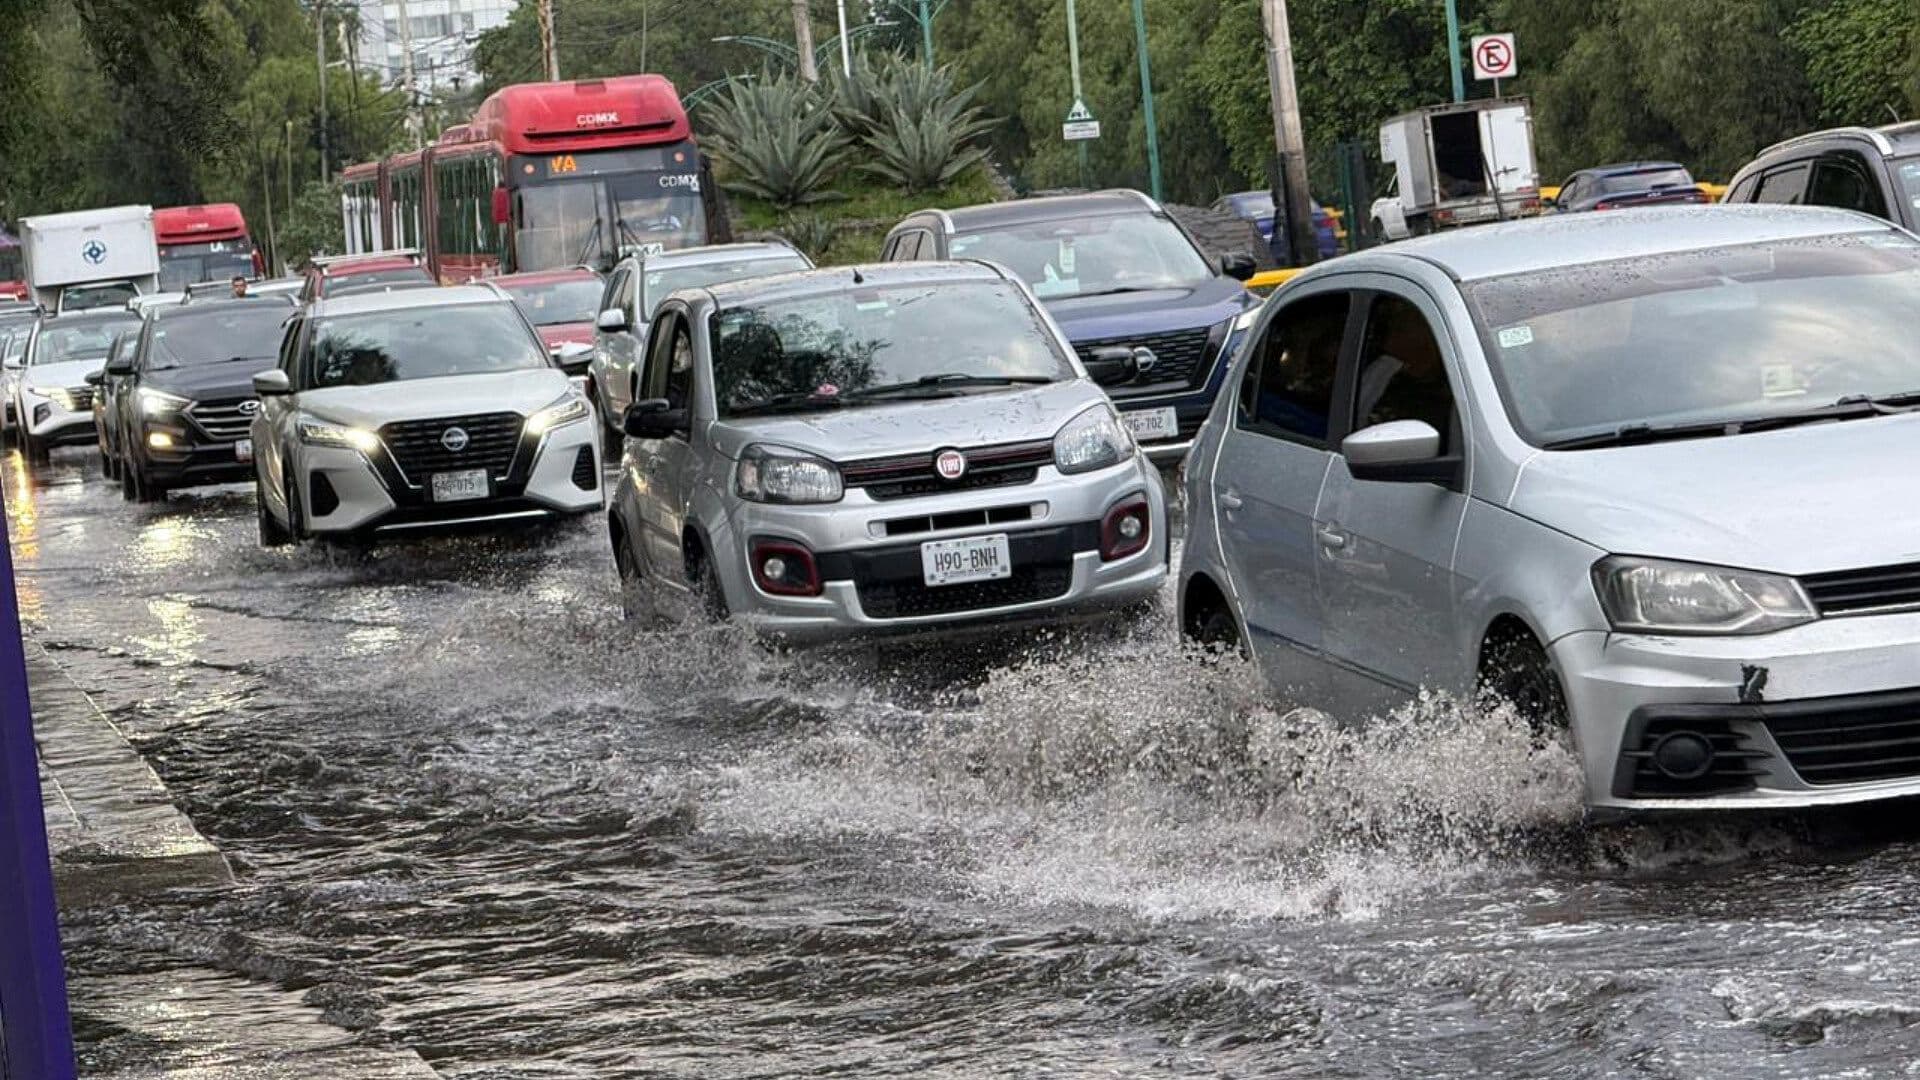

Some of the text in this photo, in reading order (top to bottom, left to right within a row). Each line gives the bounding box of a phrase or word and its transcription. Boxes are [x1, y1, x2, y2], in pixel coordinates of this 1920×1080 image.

[576, 112, 618, 125] CDMX
[659, 174, 698, 188] CDMX
[935, 547, 998, 573] H90-BNH
